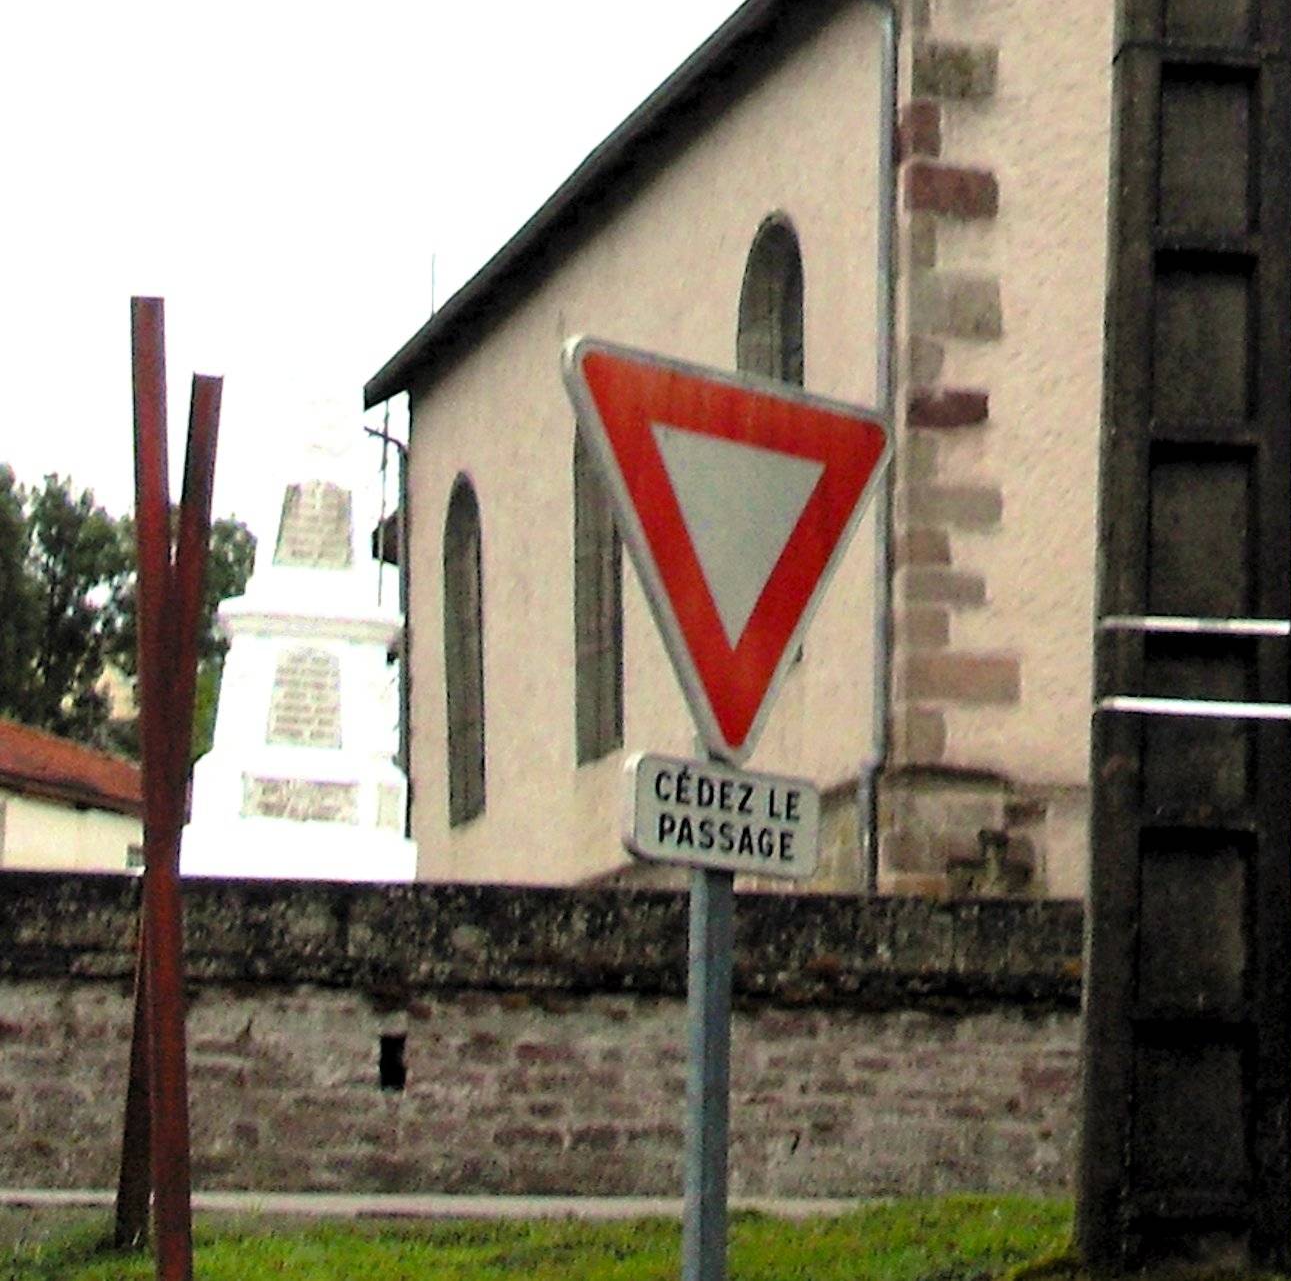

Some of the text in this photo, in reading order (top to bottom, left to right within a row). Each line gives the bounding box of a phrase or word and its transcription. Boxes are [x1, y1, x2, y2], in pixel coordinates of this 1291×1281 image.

[654, 765, 801, 822] CÉDEZ LE
[657, 813, 795, 862] PASSAGE
